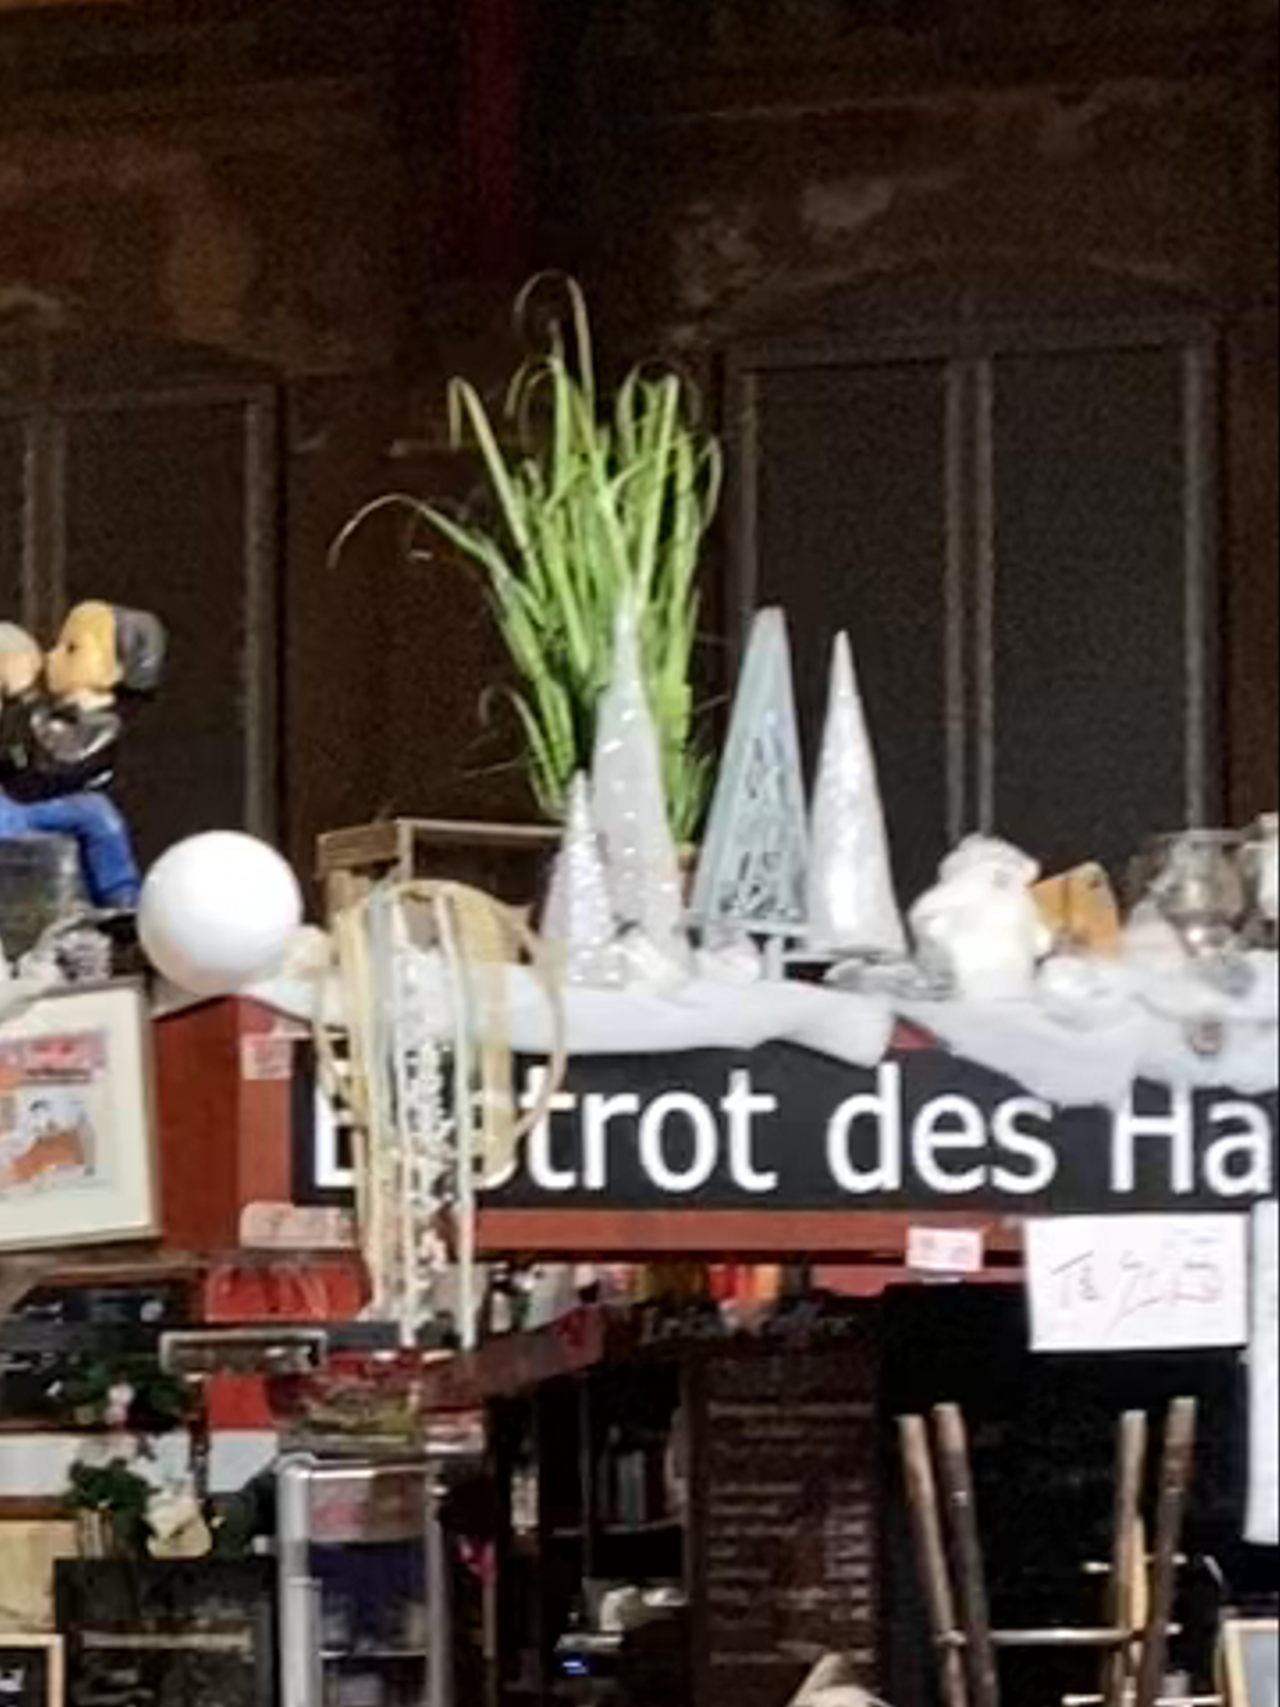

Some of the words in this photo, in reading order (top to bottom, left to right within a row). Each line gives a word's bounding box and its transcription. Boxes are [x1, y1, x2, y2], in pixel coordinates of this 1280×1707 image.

[314, 1061, 777, 1192] trot
[826, 1061, 1057, 1192] des
[1109, 1070, 1272, 1196] Ha
